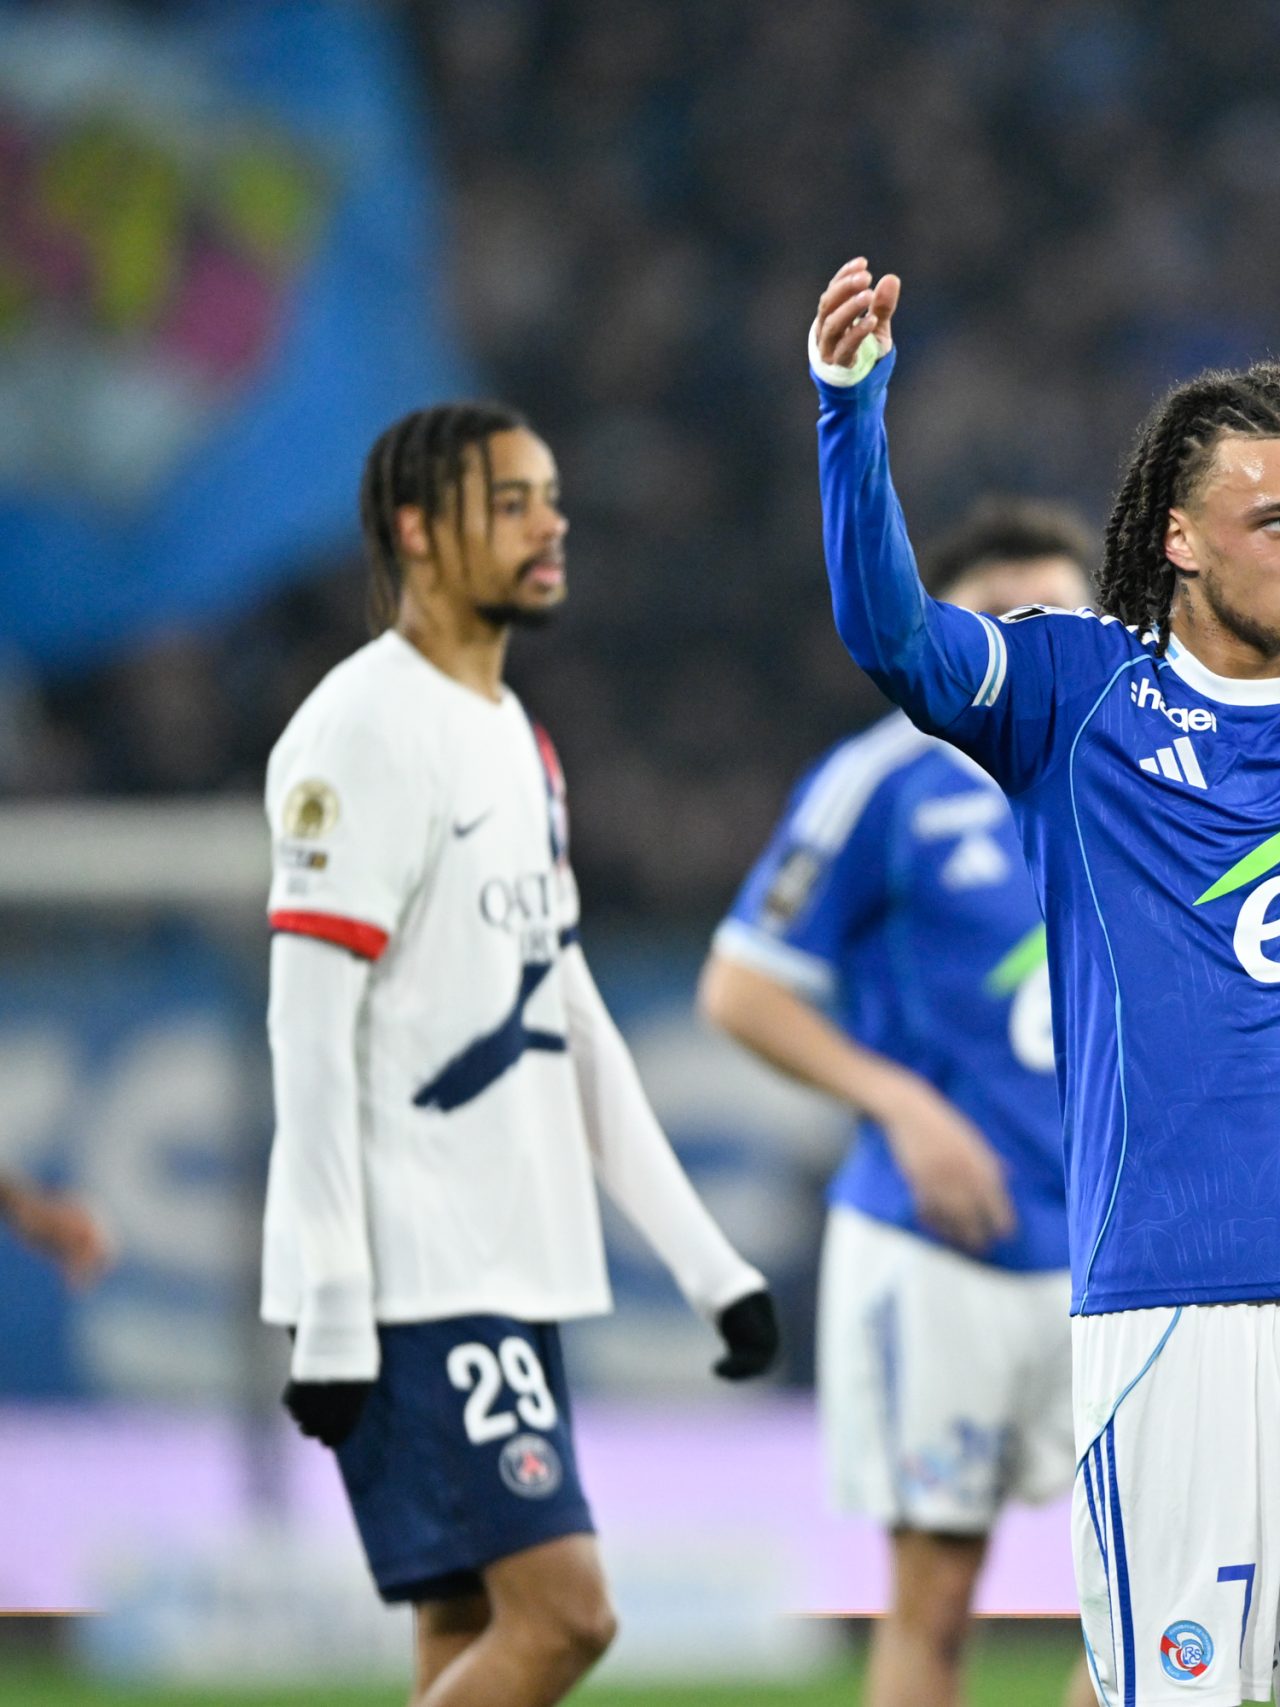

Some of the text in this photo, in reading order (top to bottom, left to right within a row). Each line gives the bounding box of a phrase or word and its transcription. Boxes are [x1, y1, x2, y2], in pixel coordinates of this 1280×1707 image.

[478, 873, 551, 934] QAT
[446, 1335, 558, 1446] 29
[1216, 1562, 1256, 1670] 7
